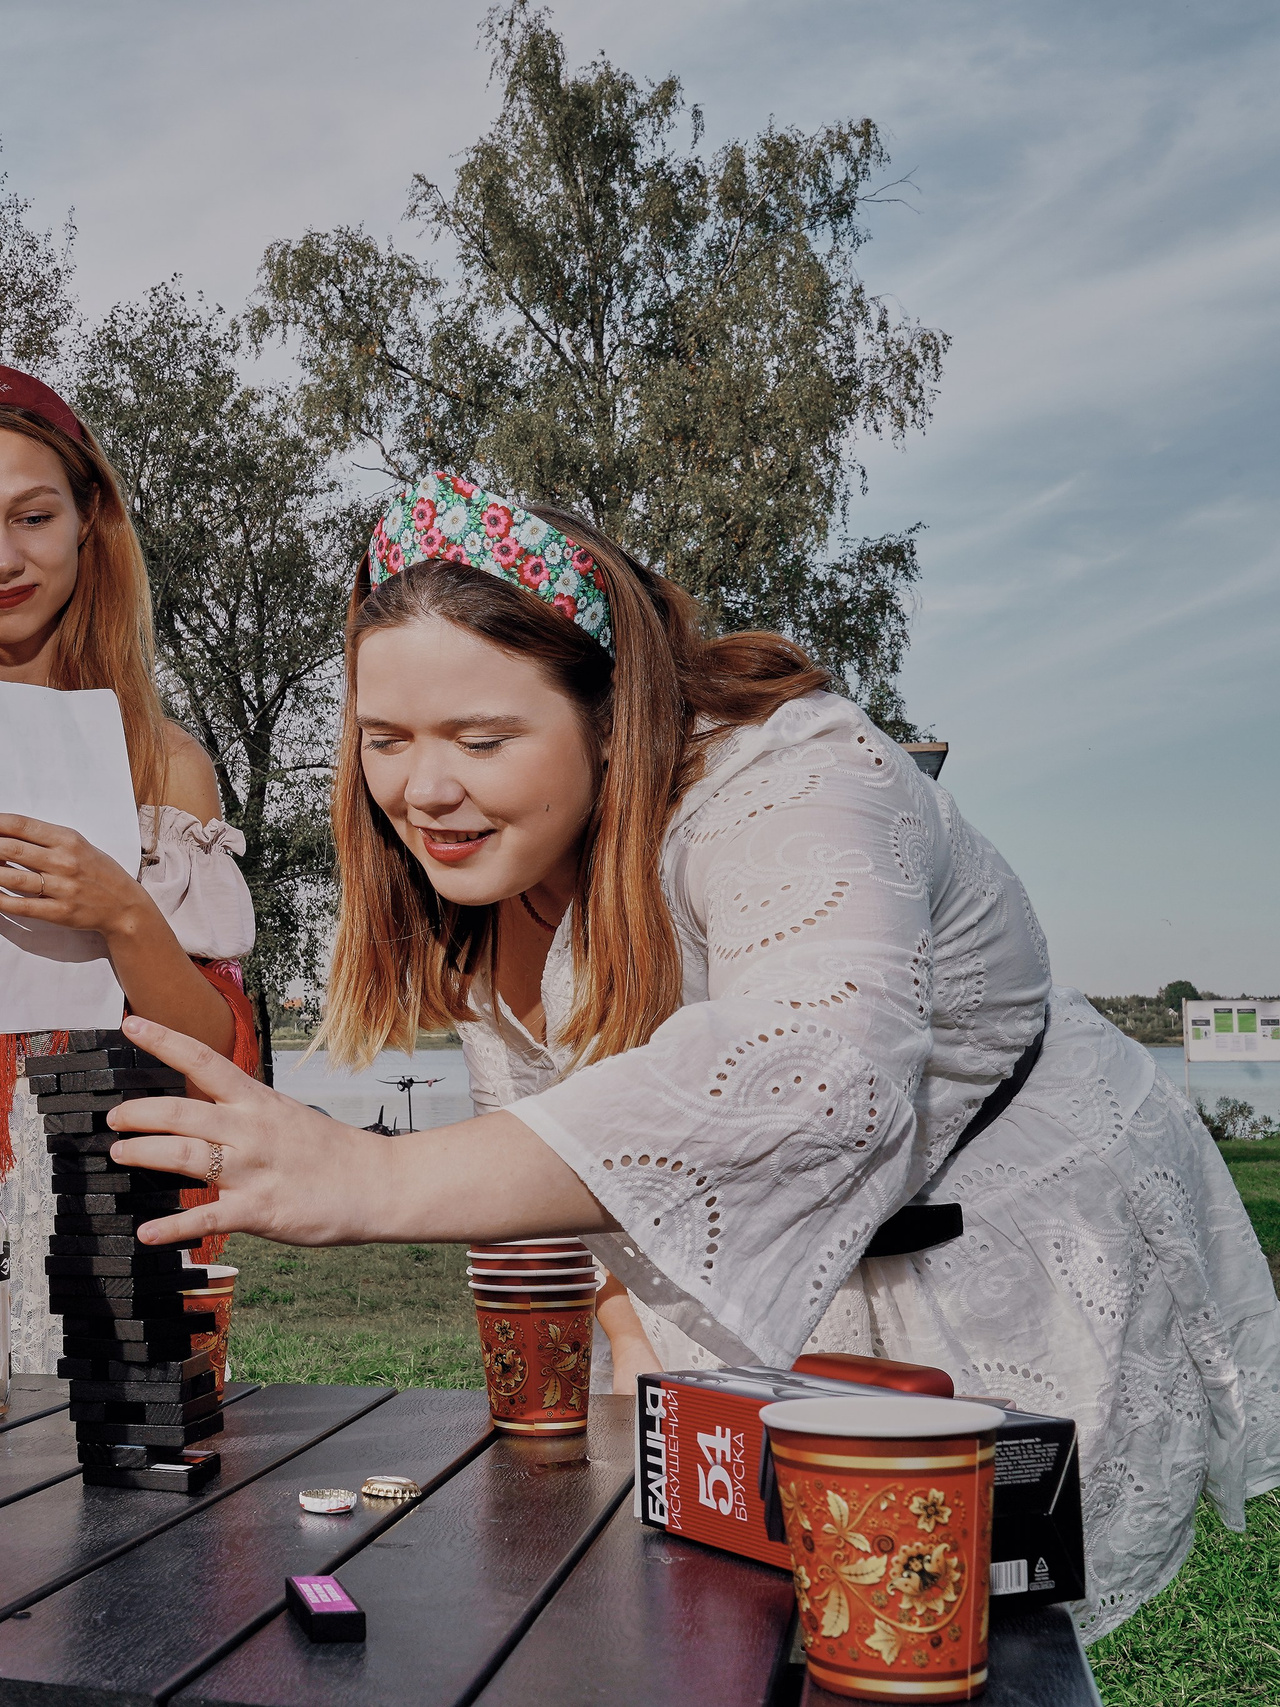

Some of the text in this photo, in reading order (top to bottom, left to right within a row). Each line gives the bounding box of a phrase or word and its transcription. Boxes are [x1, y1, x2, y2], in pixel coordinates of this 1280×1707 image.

[645, 1385, 669, 1526] БАШНЯ
[667, 1389, 683, 1531] ИСКУШЕНИЙ
[696, 1425, 734, 1516] 54
[732, 1432, 749, 1522] БРУСКА
